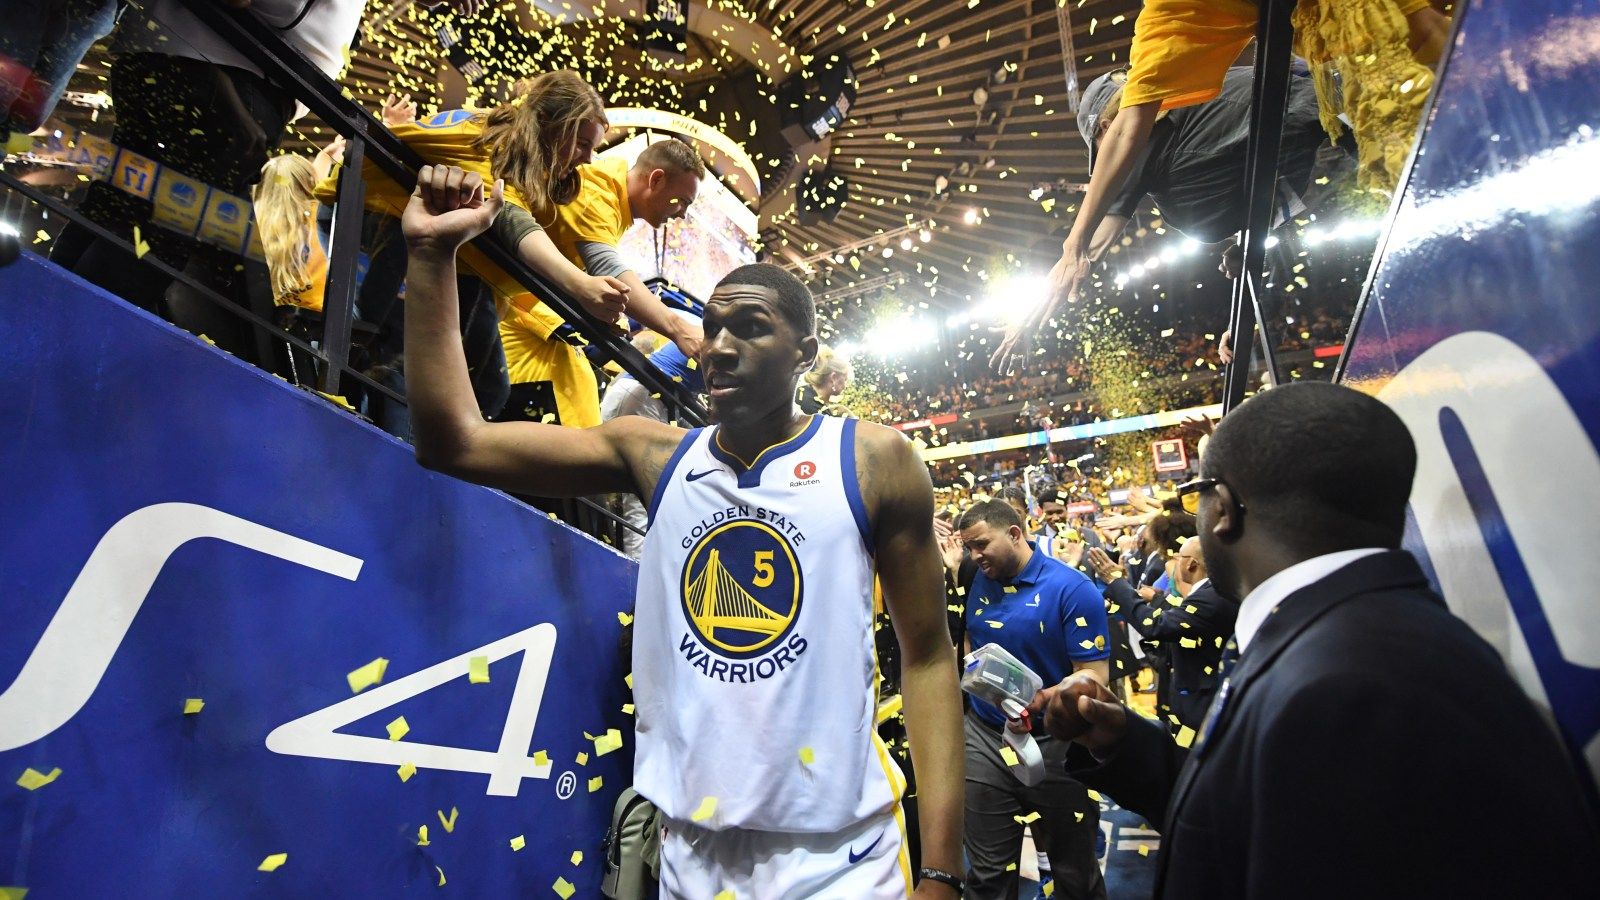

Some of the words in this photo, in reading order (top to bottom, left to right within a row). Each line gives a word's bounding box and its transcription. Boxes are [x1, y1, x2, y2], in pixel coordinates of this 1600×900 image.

[789, 479, 821, 488] Rakuten
[681, 505, 749, 549] GOLDEN
[756, 507, 806, 547] STATE
[752, 550, 775, 588] 5
[679, 632, 808, 684] WARRIORS
